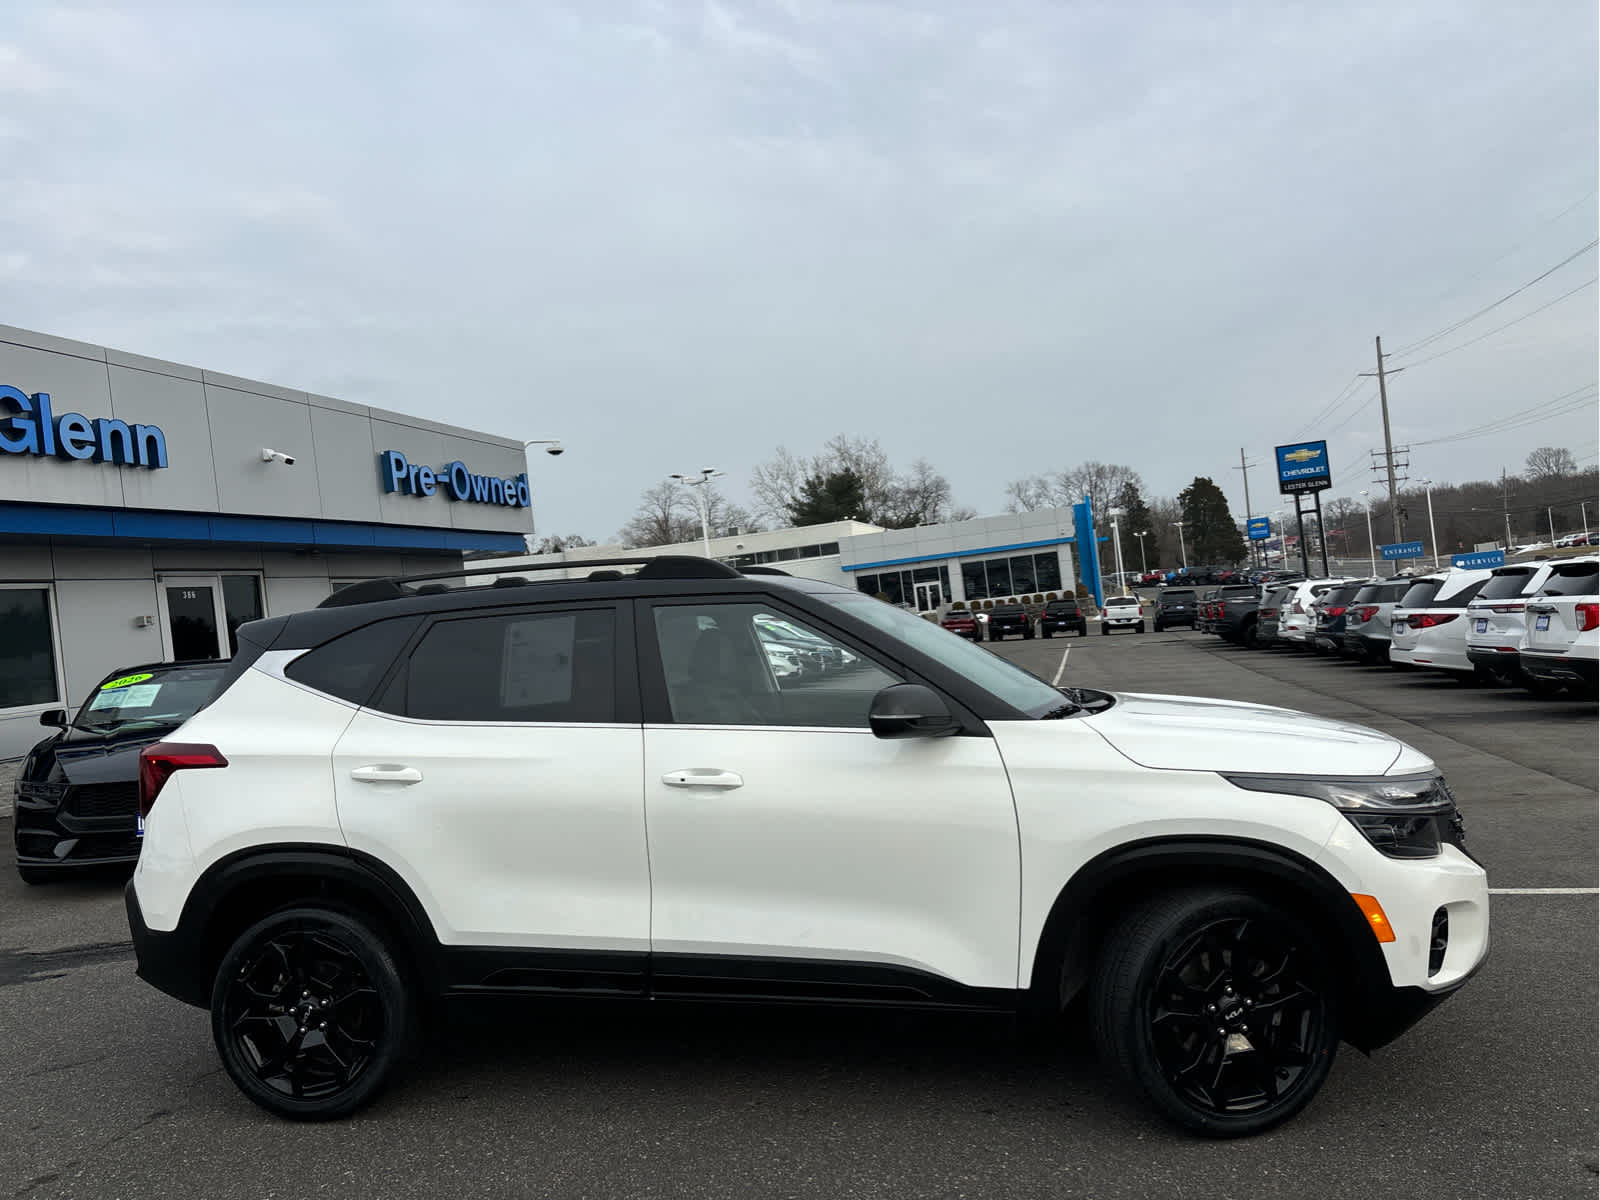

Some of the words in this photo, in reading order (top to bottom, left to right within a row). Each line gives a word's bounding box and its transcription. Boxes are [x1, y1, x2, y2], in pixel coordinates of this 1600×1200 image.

[0, 385, 168, 468] Glenn
[1283, 466, 1325, 477] CHEVROLET
[382, 450, 530, 507] Pre-Owned
[1384, 546, 1421, 556] ENTRANCE
[1466, 556, 1502, 566] SERVICE
[112, 675, 143, 687] 2026
